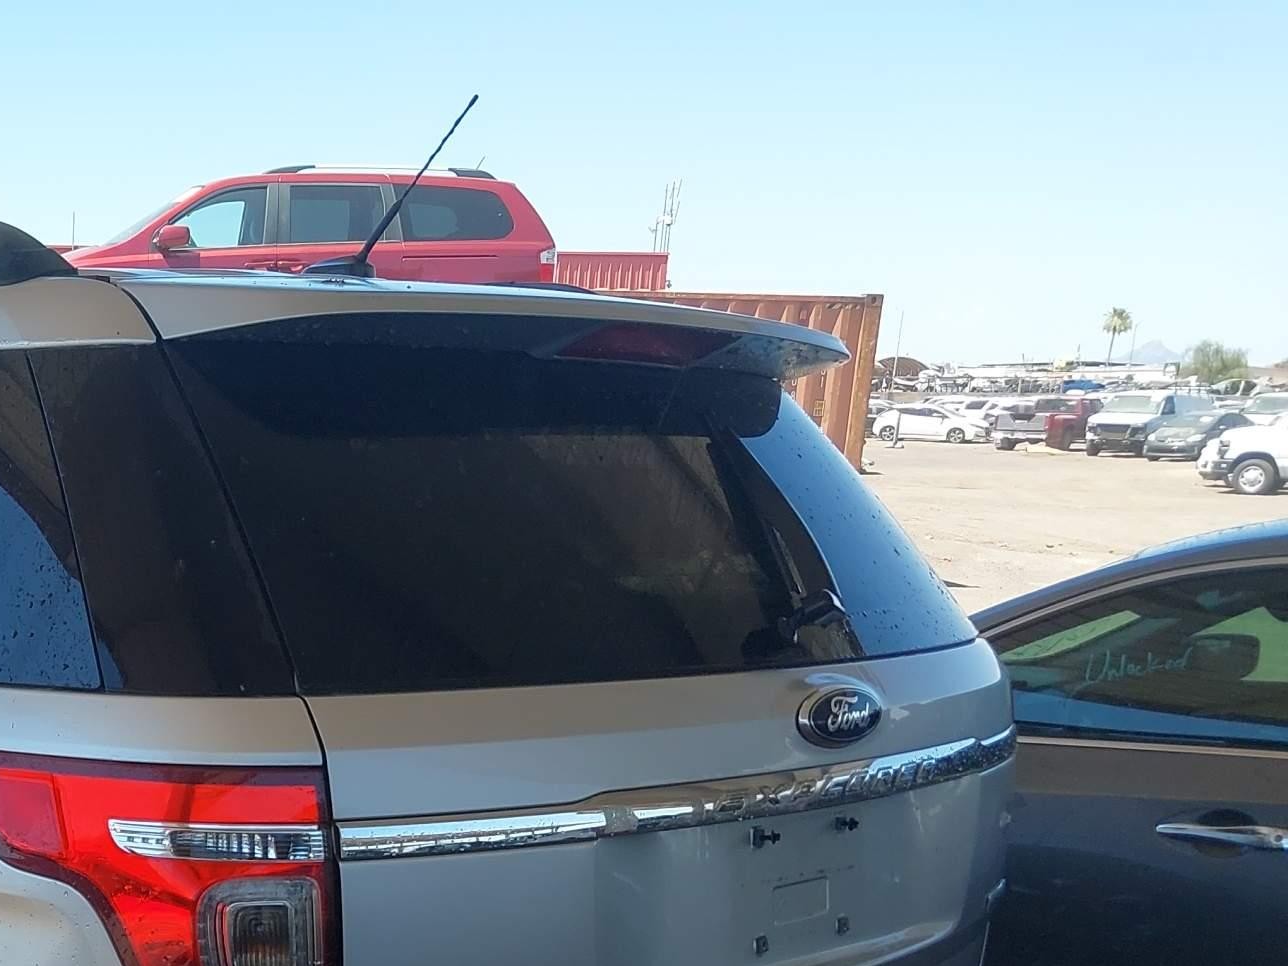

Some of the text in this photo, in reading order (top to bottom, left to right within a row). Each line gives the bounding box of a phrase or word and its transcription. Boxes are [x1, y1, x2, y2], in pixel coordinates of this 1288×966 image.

[1085, 647, 1193, 682] Unlocked
[827, 695, 871, 733] Ford
[714, 759, 937, 813] EXPLORER
